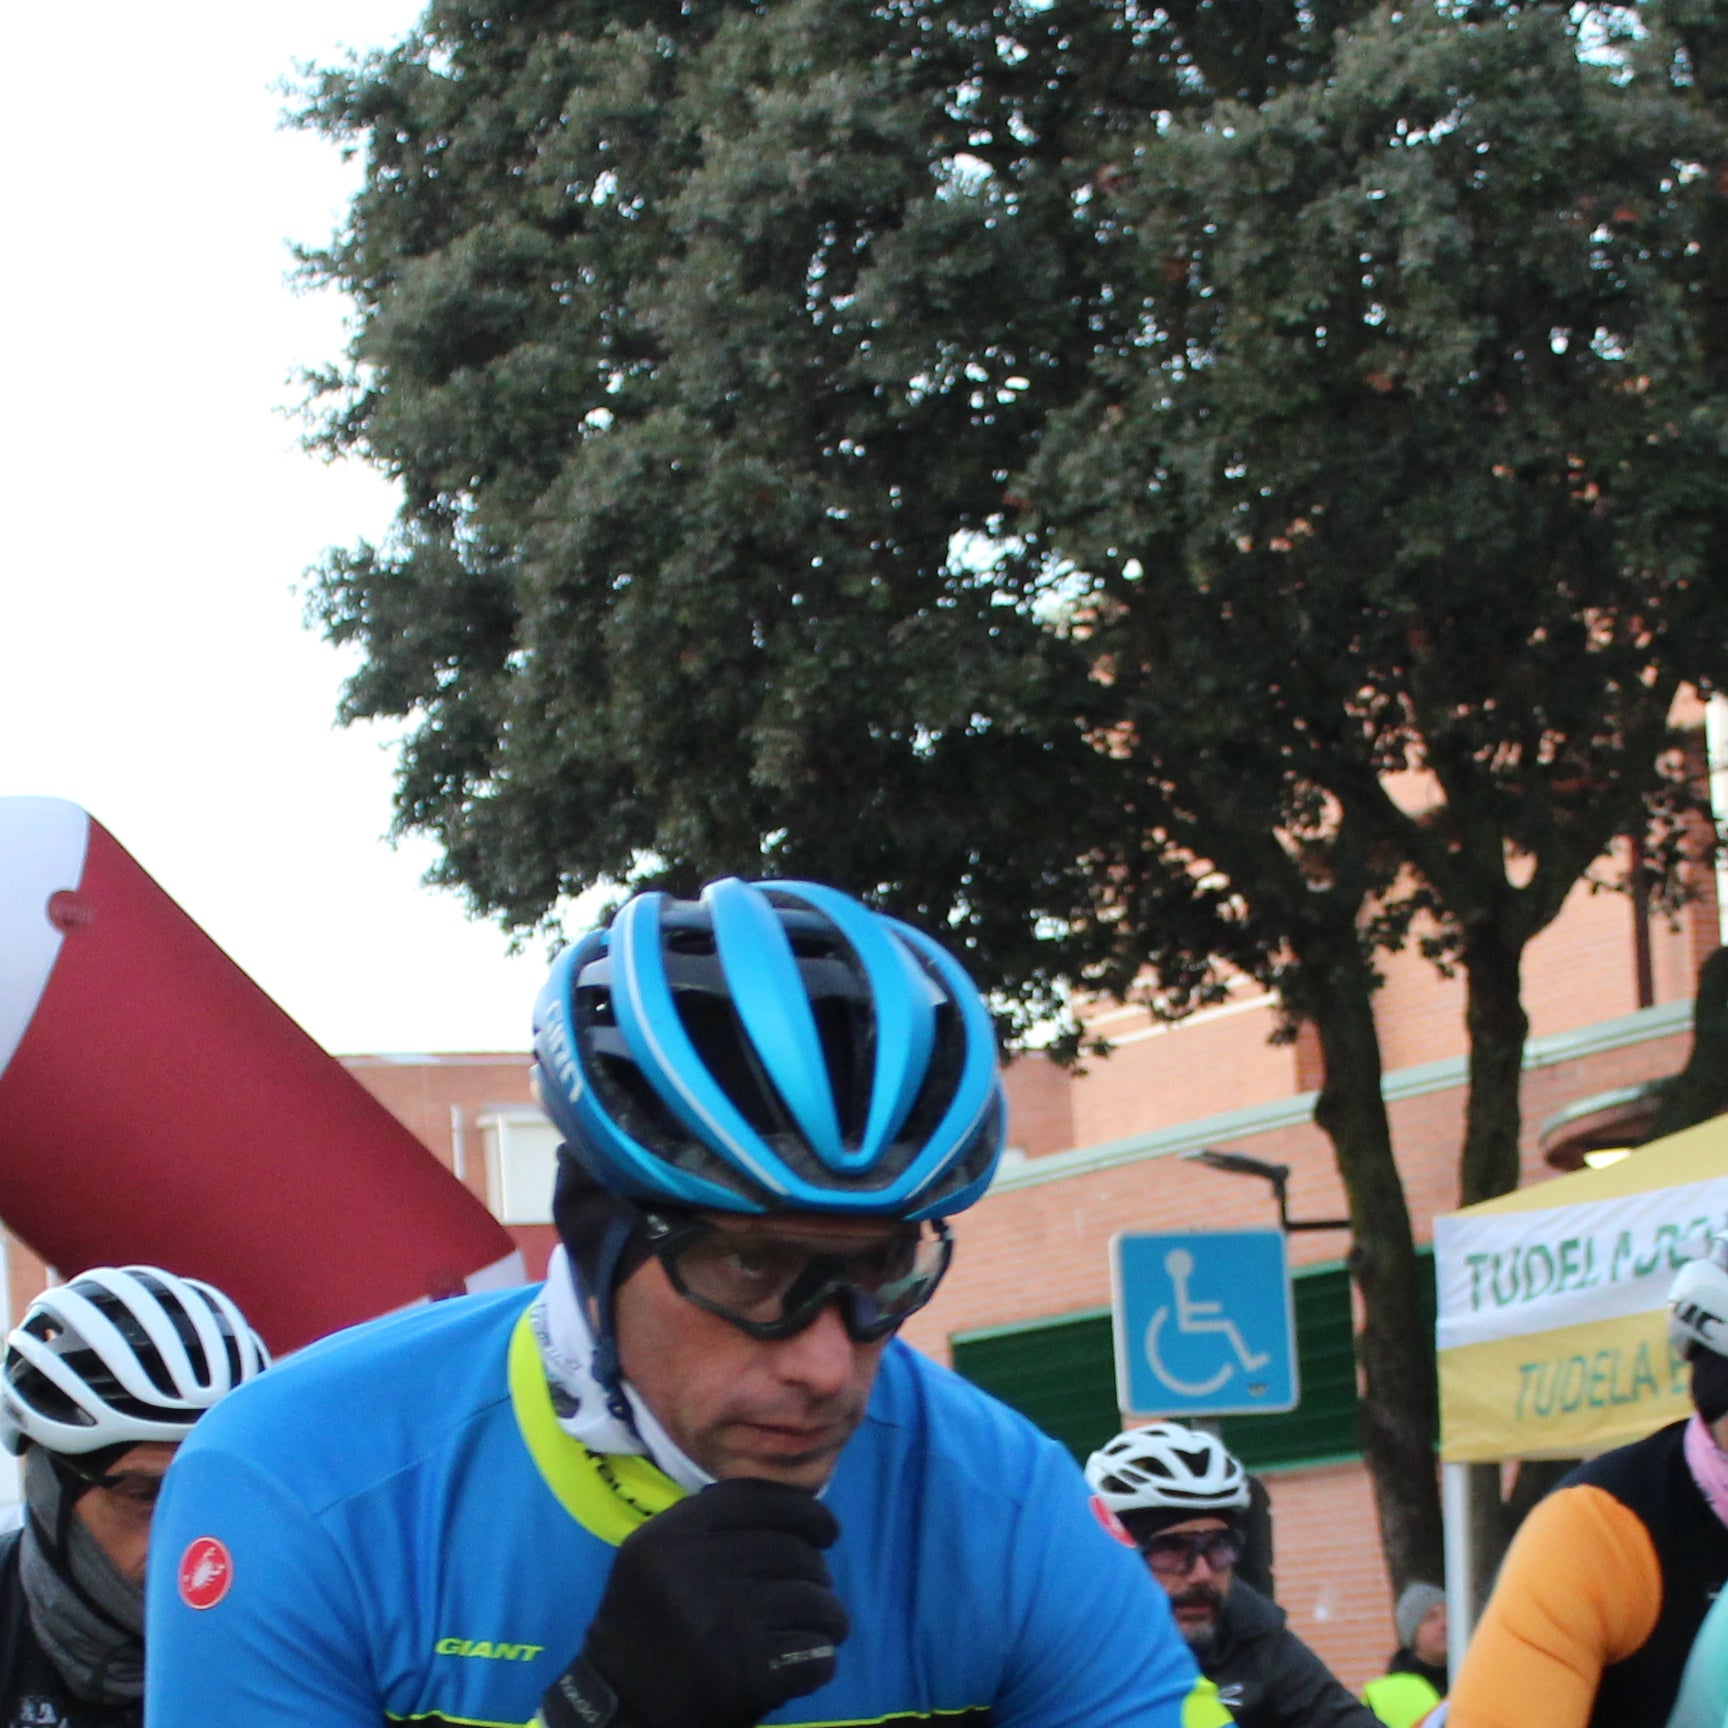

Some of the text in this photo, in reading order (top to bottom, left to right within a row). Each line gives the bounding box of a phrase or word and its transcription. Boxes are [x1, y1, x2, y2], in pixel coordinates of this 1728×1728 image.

[1464, 1229, 1632, 1312] TUDELA
[1515, 1341, 1659, 1420] TUDELA
[435, 1637, 545, 1662] GIANT
